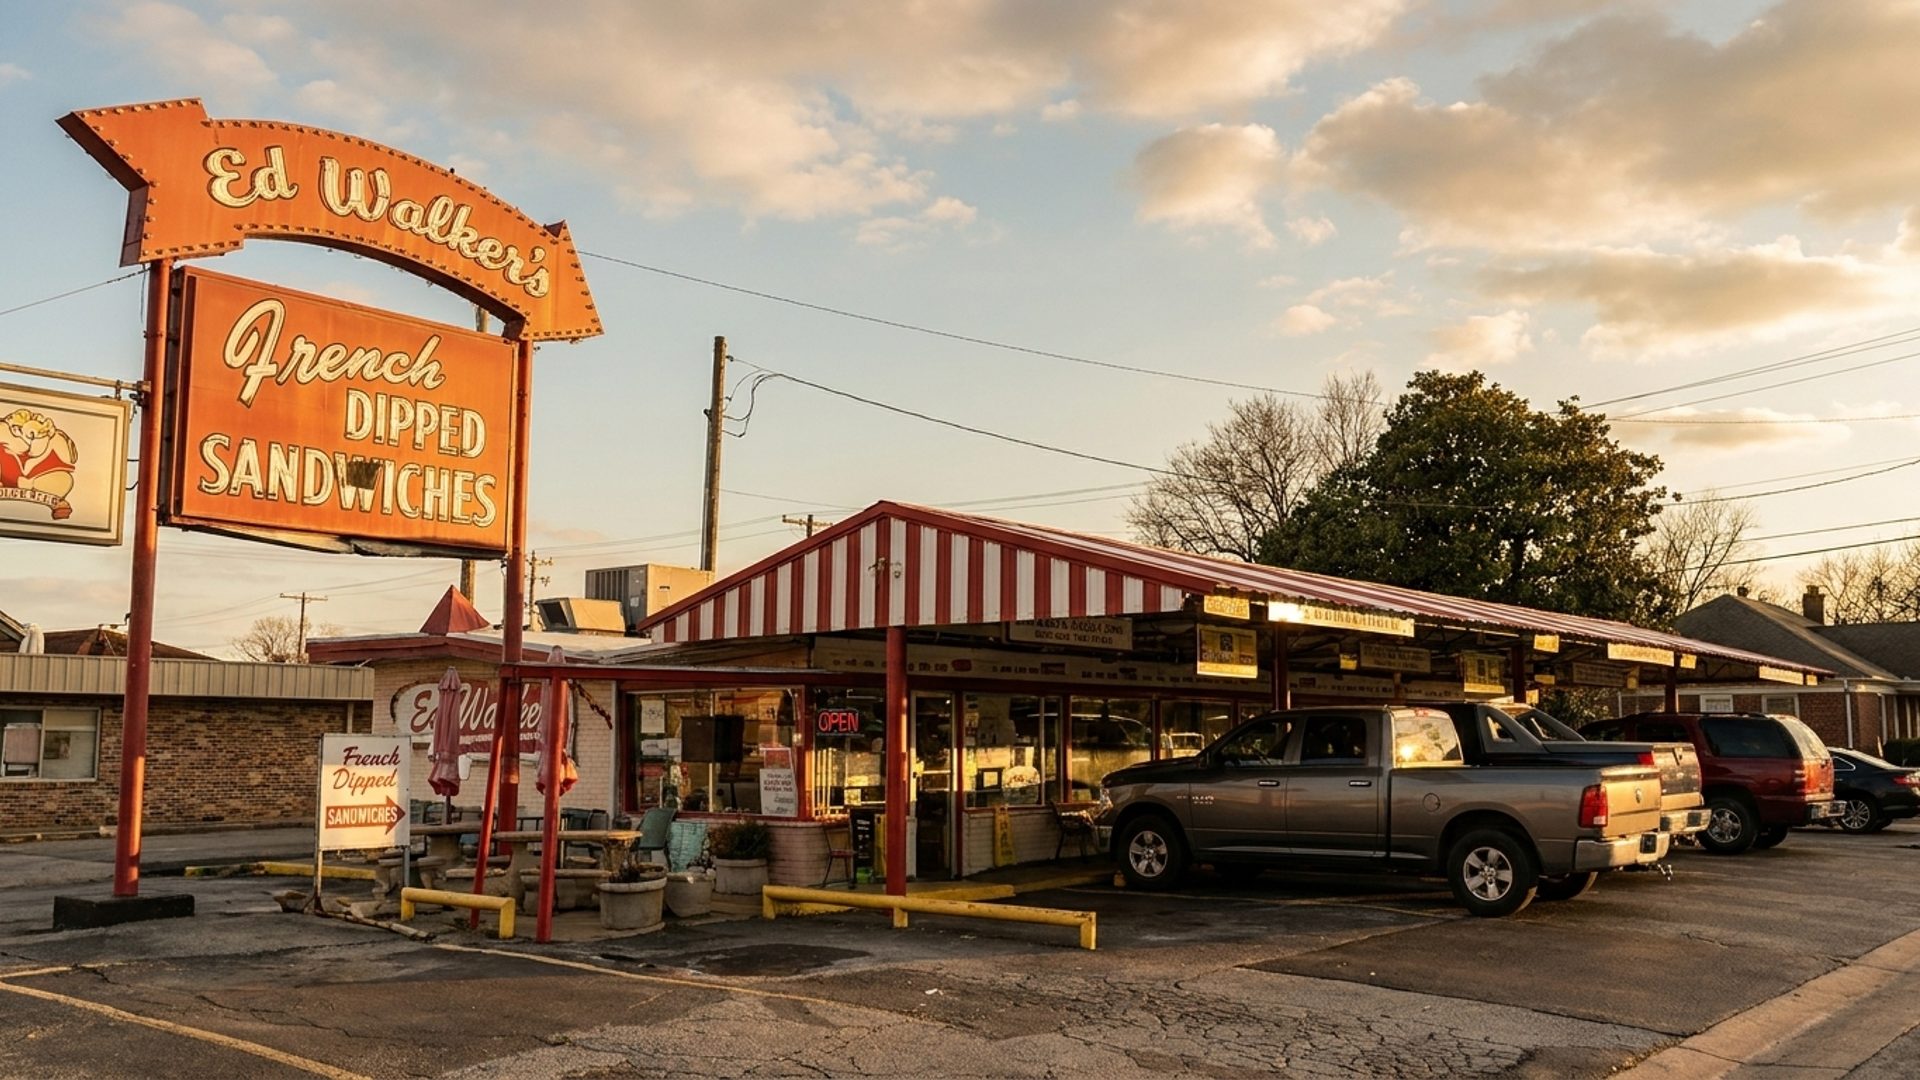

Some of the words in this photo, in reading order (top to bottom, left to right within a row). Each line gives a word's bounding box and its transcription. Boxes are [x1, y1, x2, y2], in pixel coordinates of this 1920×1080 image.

[203, 145, 299, 208] Ed
[318, 155, 551, 298] Walker's
[222, 298, 445, 408] French
[345, 388, 486, 459] DIPPED
[198, 432, 497, 528] SANDWICHES
[343, 745, 401, 766] French
[818, 711, 859, 732] OPEN
[333, 767, 398, 796] Dipped
